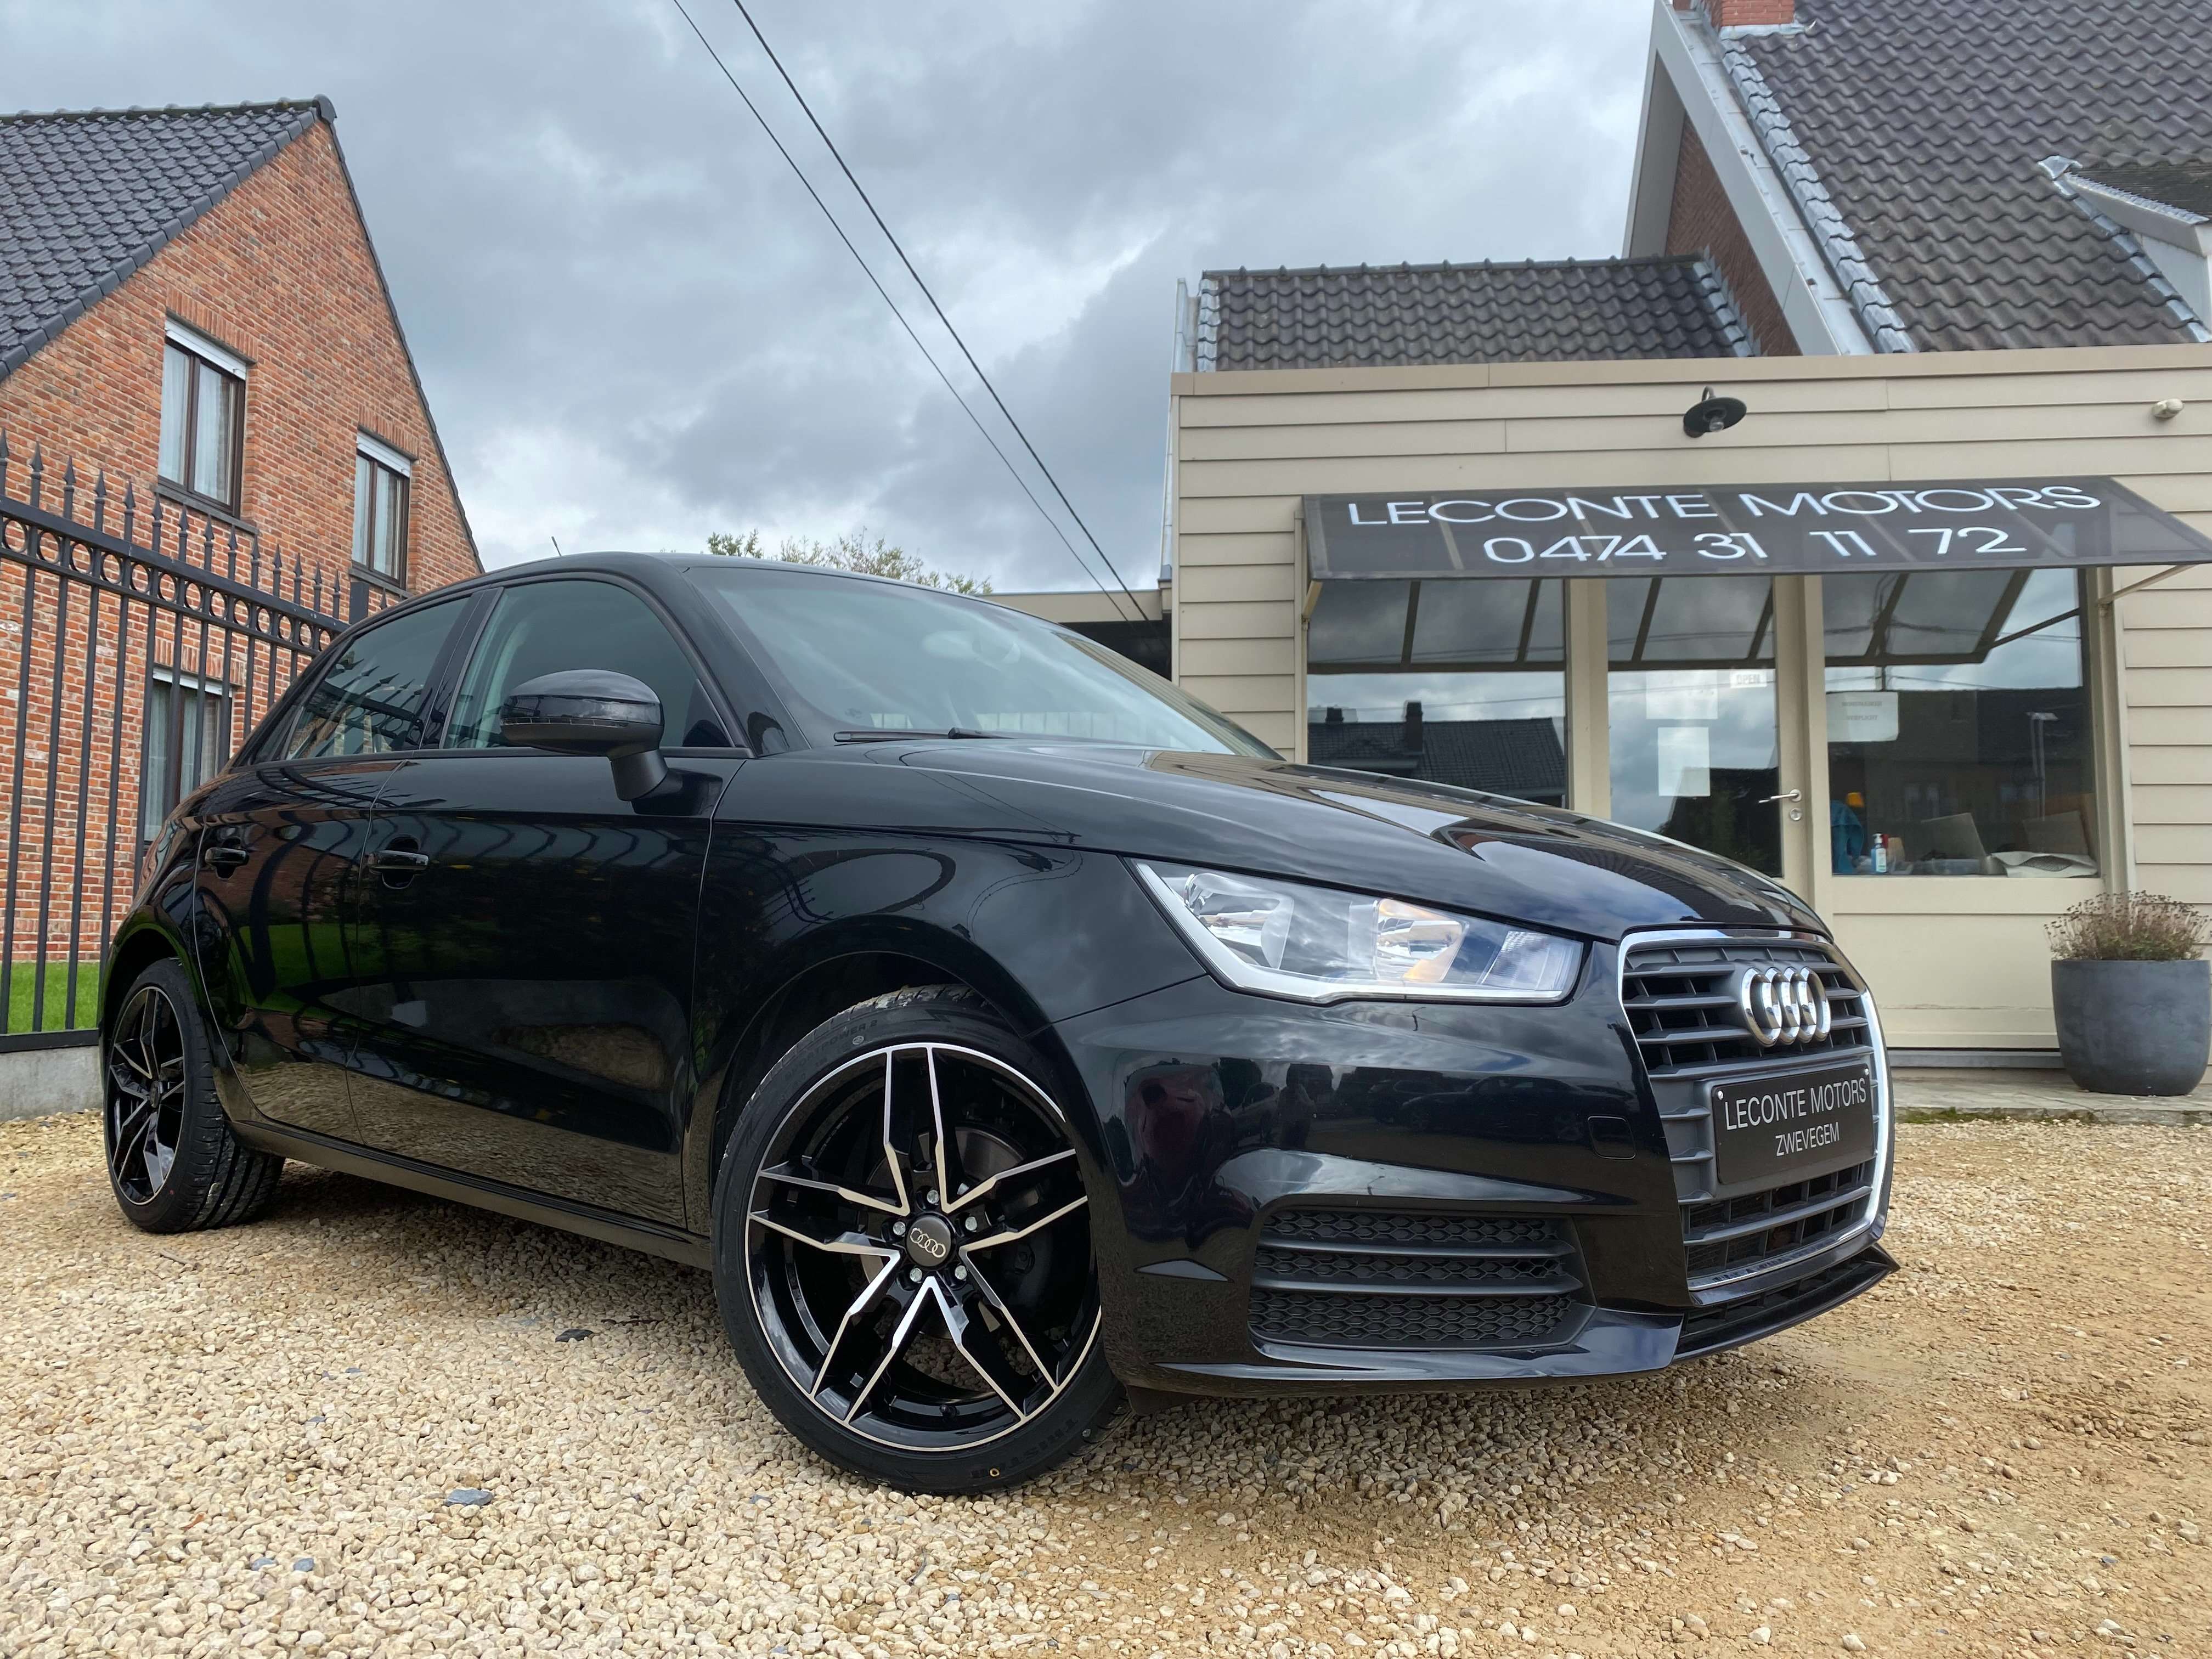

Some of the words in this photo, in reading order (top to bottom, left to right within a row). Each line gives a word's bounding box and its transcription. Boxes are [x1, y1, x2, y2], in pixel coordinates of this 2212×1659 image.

[1348, 495, 1718, 524] LECONTE
[1739, 486, 2101, 517] MOTORS
[1483, 534, 1667, 563] 0474
[1694, 533, 1768, 559] 31
[1809, 531, 1877, 556] 11
[1908, 527, 2028, 555] 72
[1736, 674, 1761, 685] OPEN
[1724, 1089, 1807, 1131] LECONTE
[1810, 1077, 1866, 1114] MOTORS
[1775, 1122, 1839, 1156] ZWEVEGEM
